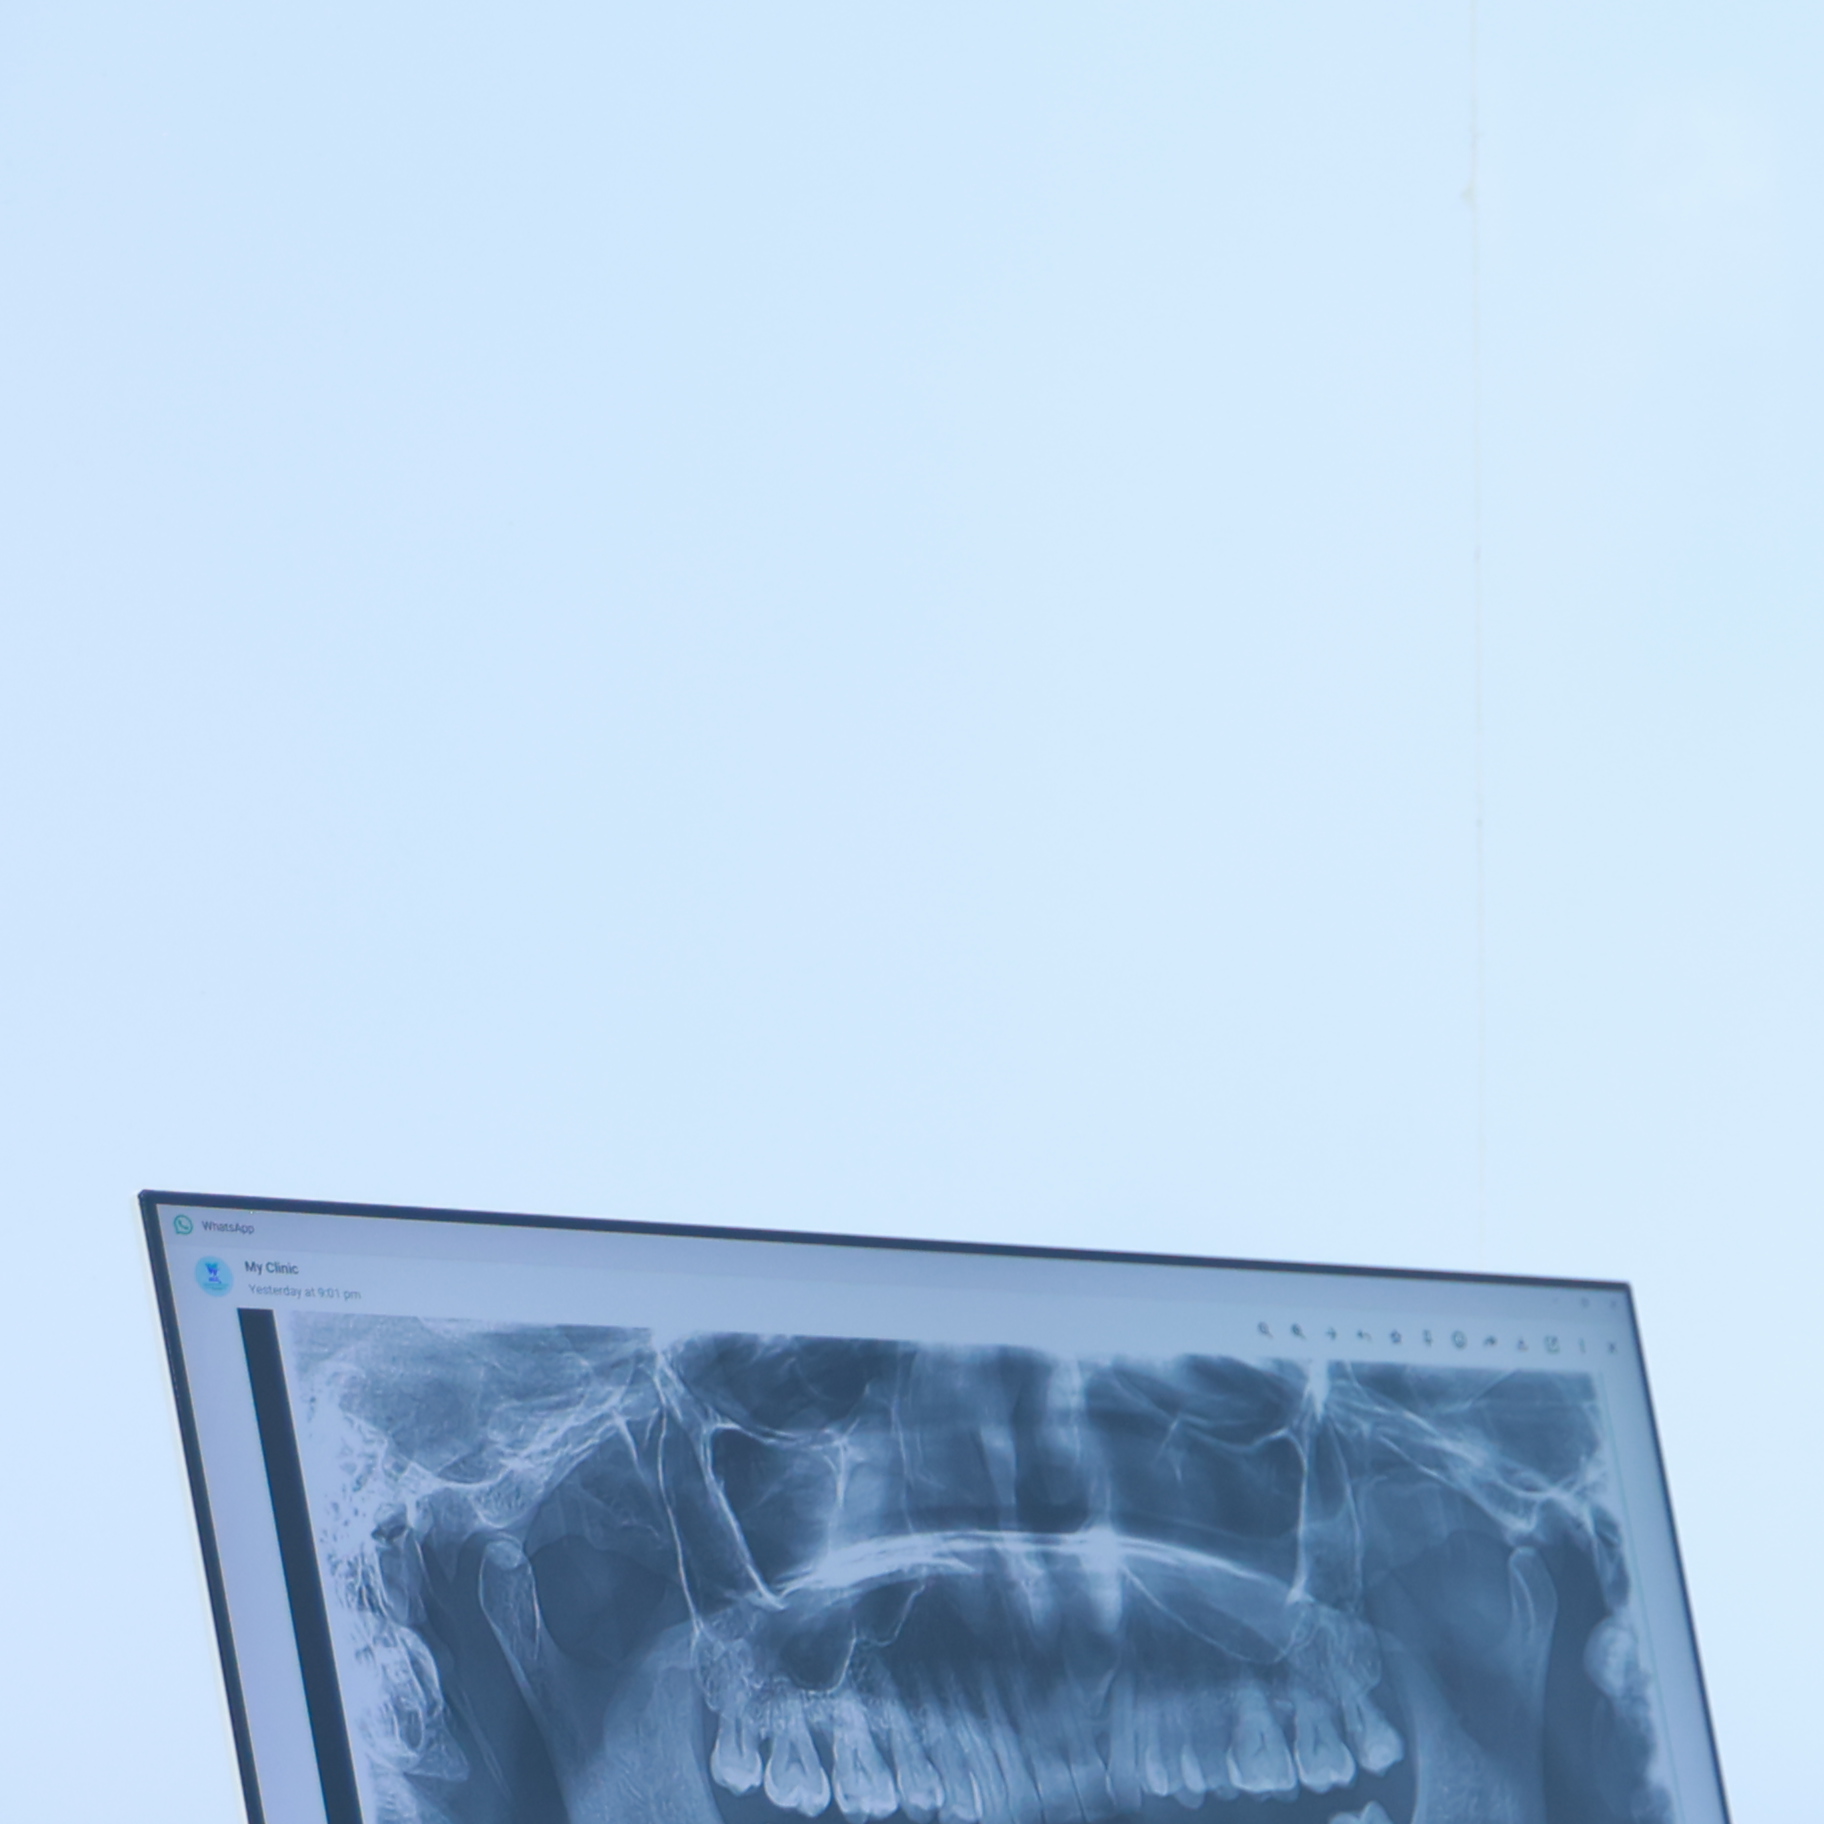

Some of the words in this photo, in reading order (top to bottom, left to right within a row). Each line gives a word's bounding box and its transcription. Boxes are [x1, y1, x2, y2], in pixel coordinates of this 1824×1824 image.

[201, 1220, 255, 1235] WhatsApp
[244, 1261, 263, 1276] My
[265, 1261, 299, 1276] Clinic
[248, 1283, 301, 1299] Yesterday
[305, 1288, 316, 1298] at
[318, 1287, 340, 1299] 9:01
[343, 1290, 362, 1301] pm
